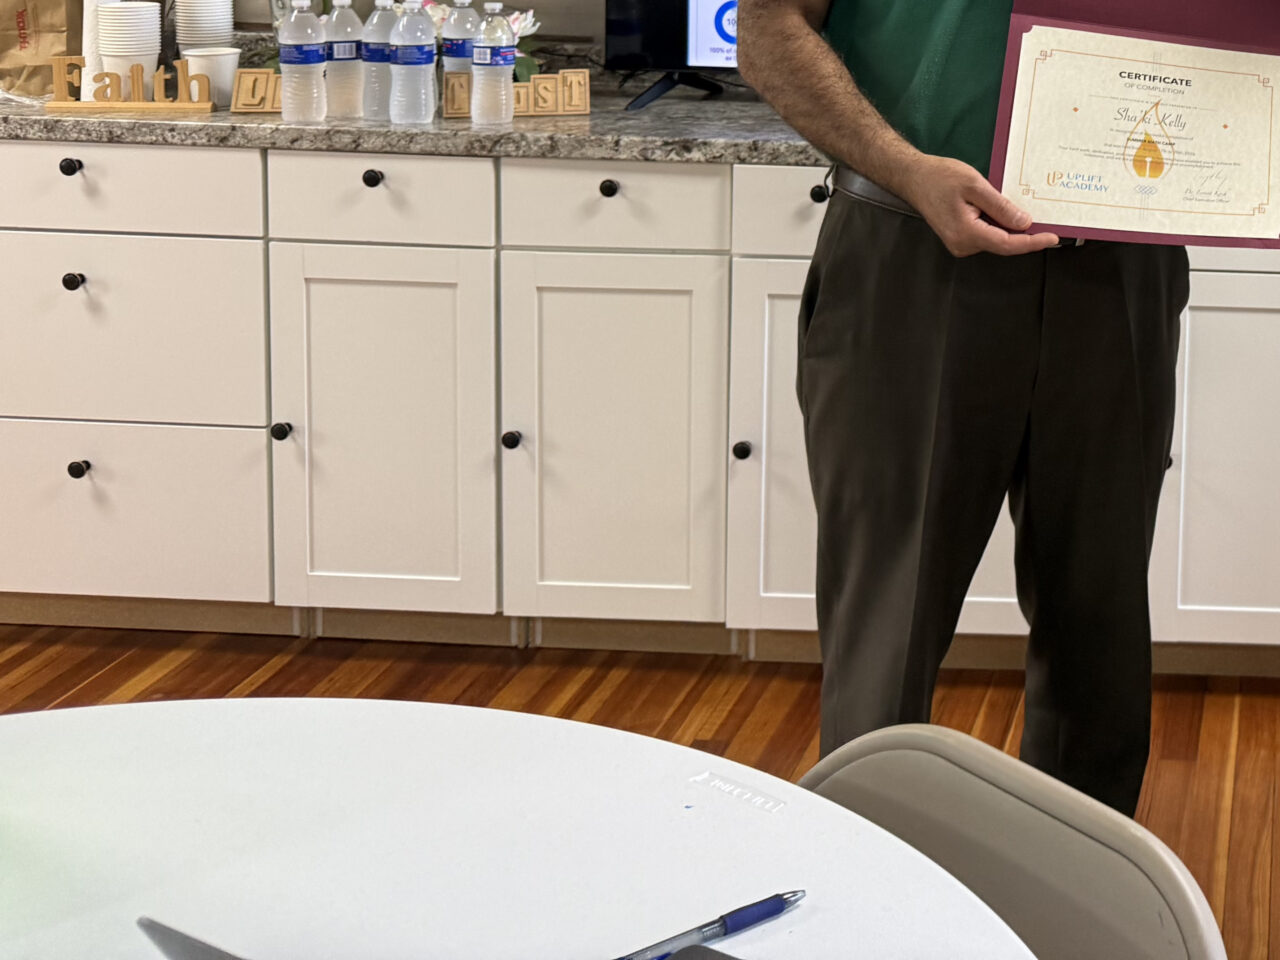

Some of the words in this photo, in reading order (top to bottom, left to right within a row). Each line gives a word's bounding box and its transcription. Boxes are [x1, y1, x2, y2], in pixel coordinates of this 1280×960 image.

[1119, 70, 1192, 87] CERTIFICATE
[1136, 84, 1185, 96] COMPLETION
[1154, 112, 1187, 131] Kelly
[1066, 171, 1103, 183] UPLIFT
[1059, 180, 1109, 193] ACADEMY
